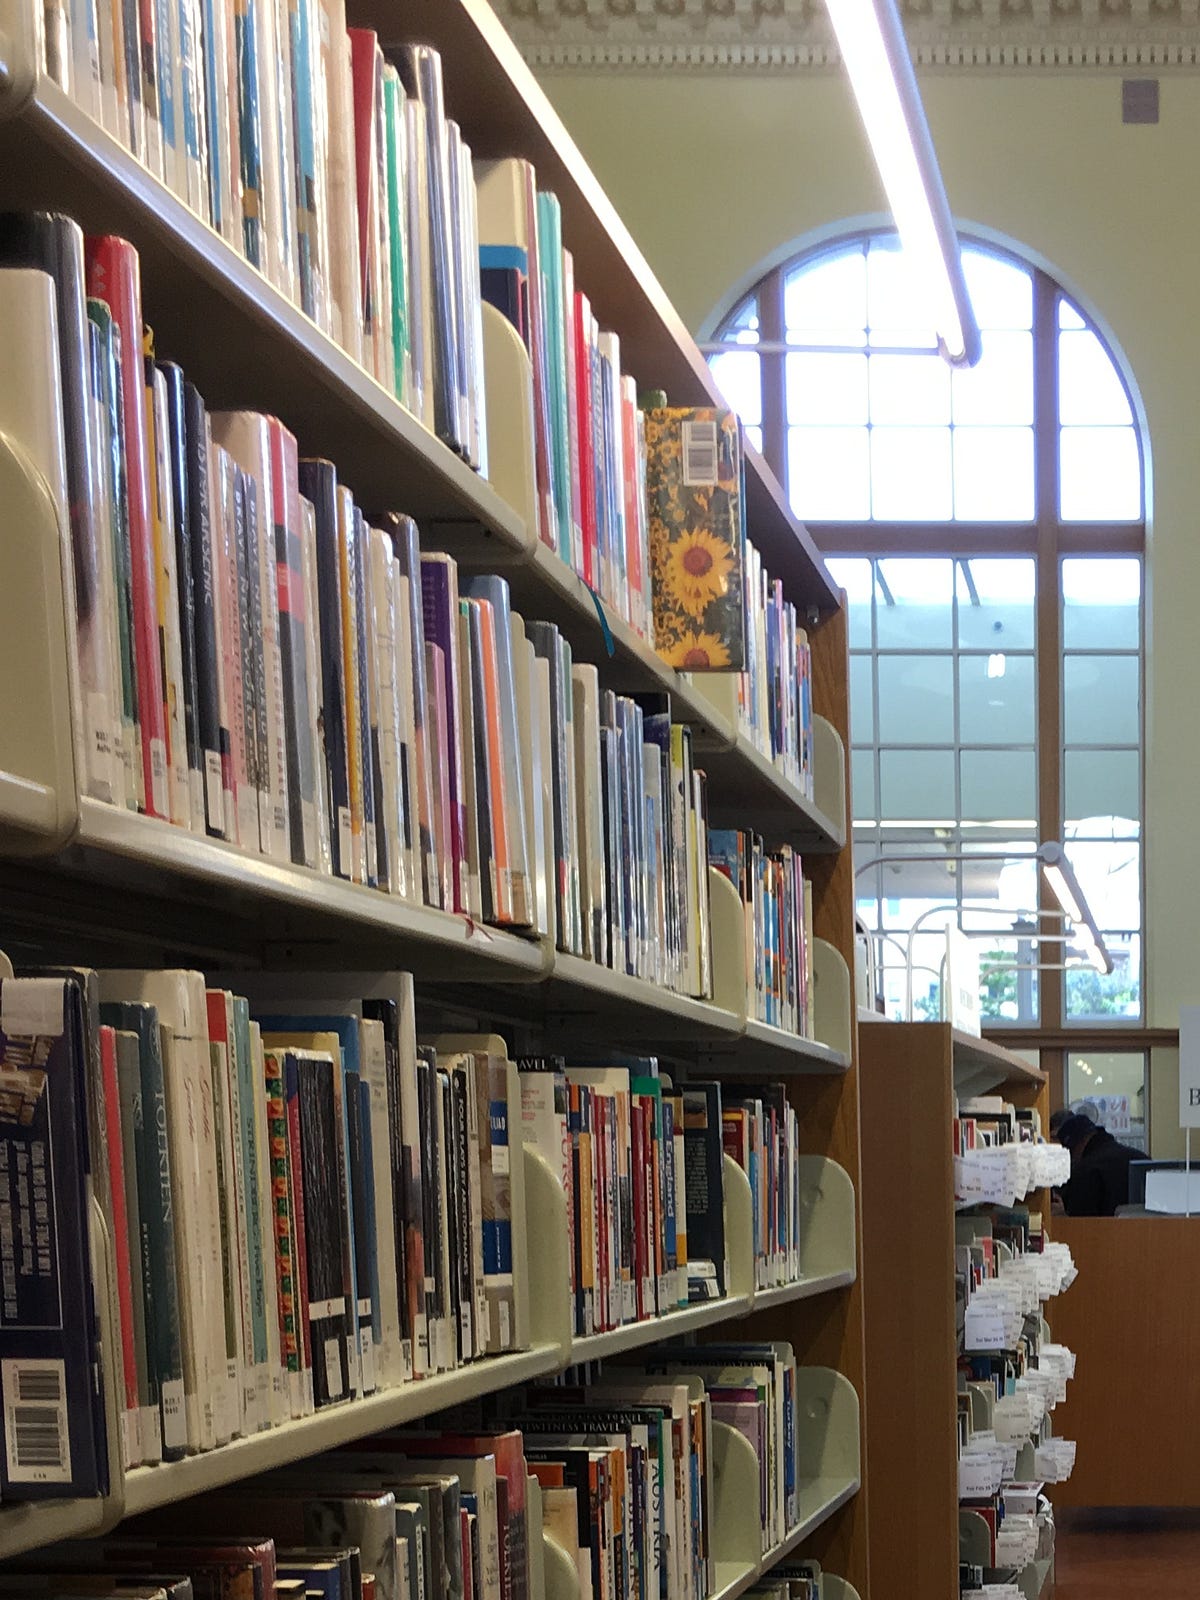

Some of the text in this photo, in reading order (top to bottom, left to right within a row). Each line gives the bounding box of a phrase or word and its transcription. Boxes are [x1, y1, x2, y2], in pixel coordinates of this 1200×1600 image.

[201, 513, 213, 607] ARSENIC
[250, 500, 259, 572] BRAVE
[240, 577, 249, 632] NEW
[155, 1088, 170, 1223] TOLKIEN
[582, 1422, 621, 1433] TRAVEL
